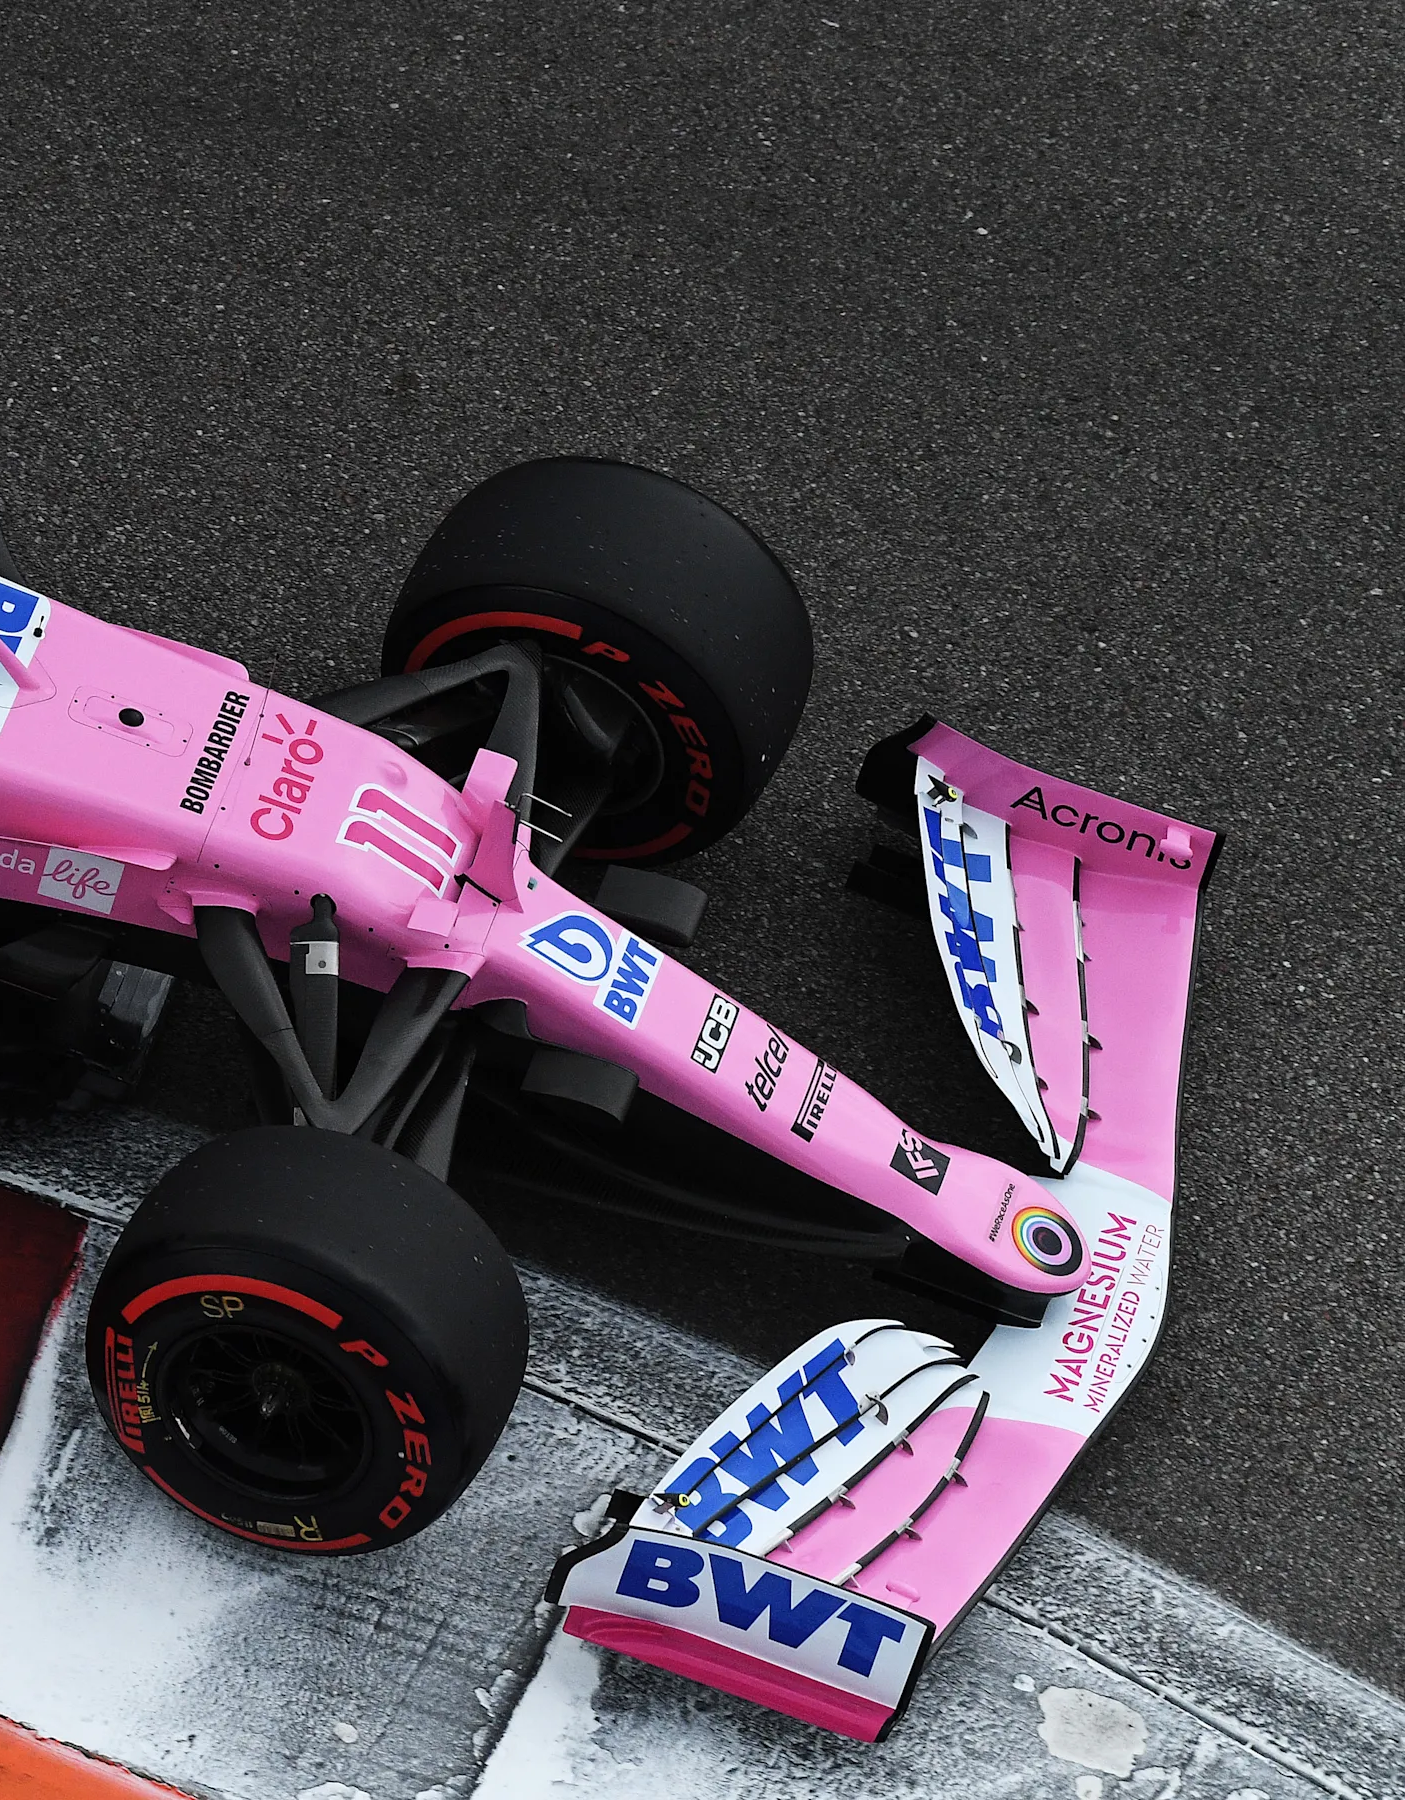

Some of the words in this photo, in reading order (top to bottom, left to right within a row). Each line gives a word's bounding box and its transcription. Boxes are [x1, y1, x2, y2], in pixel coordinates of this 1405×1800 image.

[179, 690, 250, 815] BOMBARDIER
[581, 640, 632, 664] P
[638, 680, 714, 817] ZERO
[250, 735, 324, 841] Claro
[335, 783, 462, 898] 11
[43, 852, 118, 900] life
[603, 935, 658, 1025] BWT
[697, 996, 738, 1071] JCB
[745, 1023, 790, 1113] telcel
[989, 1183, 1016, 1243] #WeRaceAsOne
[199, 1295, 246, 1319] SP
[1043, 1211, 1138, 1403] MAGNESIUM
[1082, 1290, 1141, 1414] MINERALIZED
[1126, 1223, 1165, 1286] WATER
[105, 1326, 146, 1454] PIRELLI
[340, 1339, 390, 1367] P
[378, 1388, 433, 1530] ZERO
[663, 1337, 867, 1550] BWT
[293, 1515, 325, 1542] R
[615, 1539, 906, 1678] BWT
